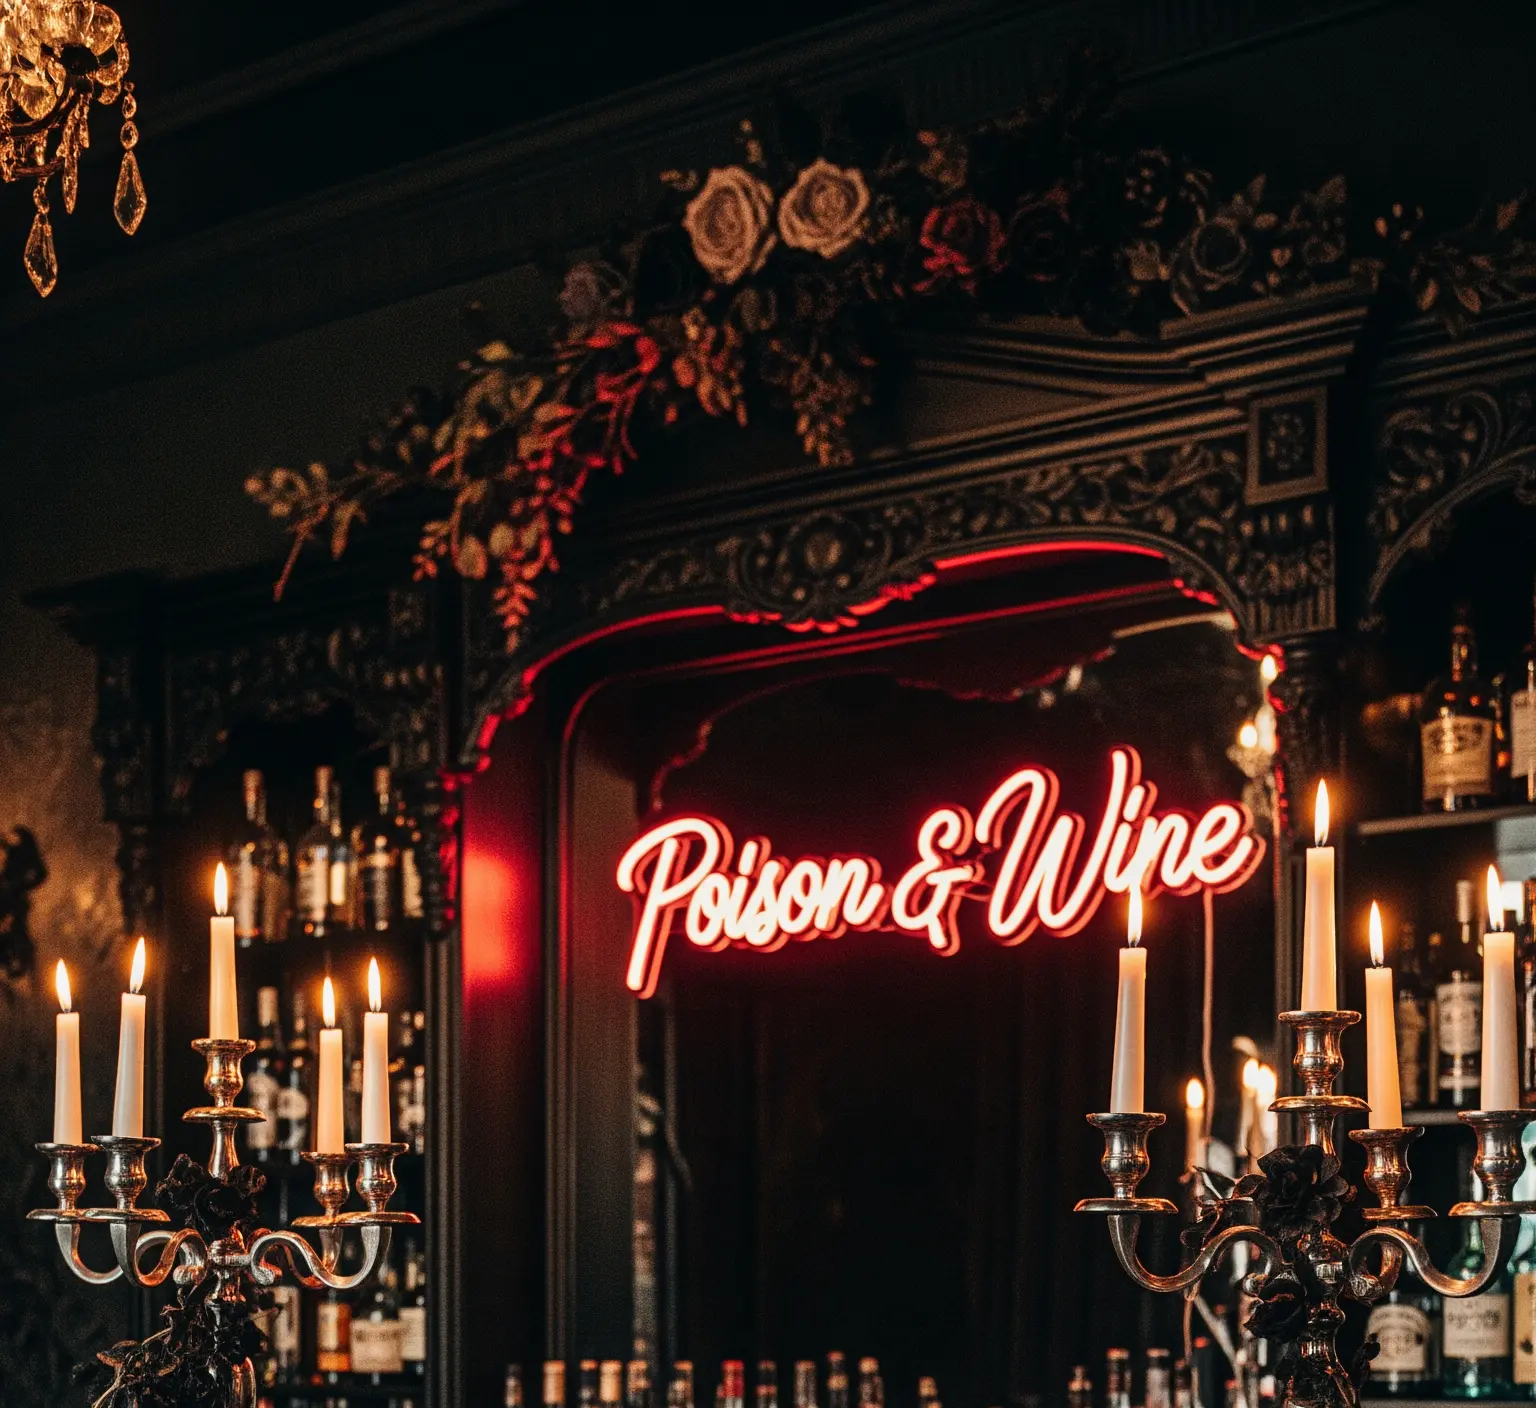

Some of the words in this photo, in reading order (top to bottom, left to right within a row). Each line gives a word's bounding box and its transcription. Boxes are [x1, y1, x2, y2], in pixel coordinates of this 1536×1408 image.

[616, 817, 888, 996] Poison
[892, 806, 976, 953] &
[975, 746, 1263, 945] Wine
